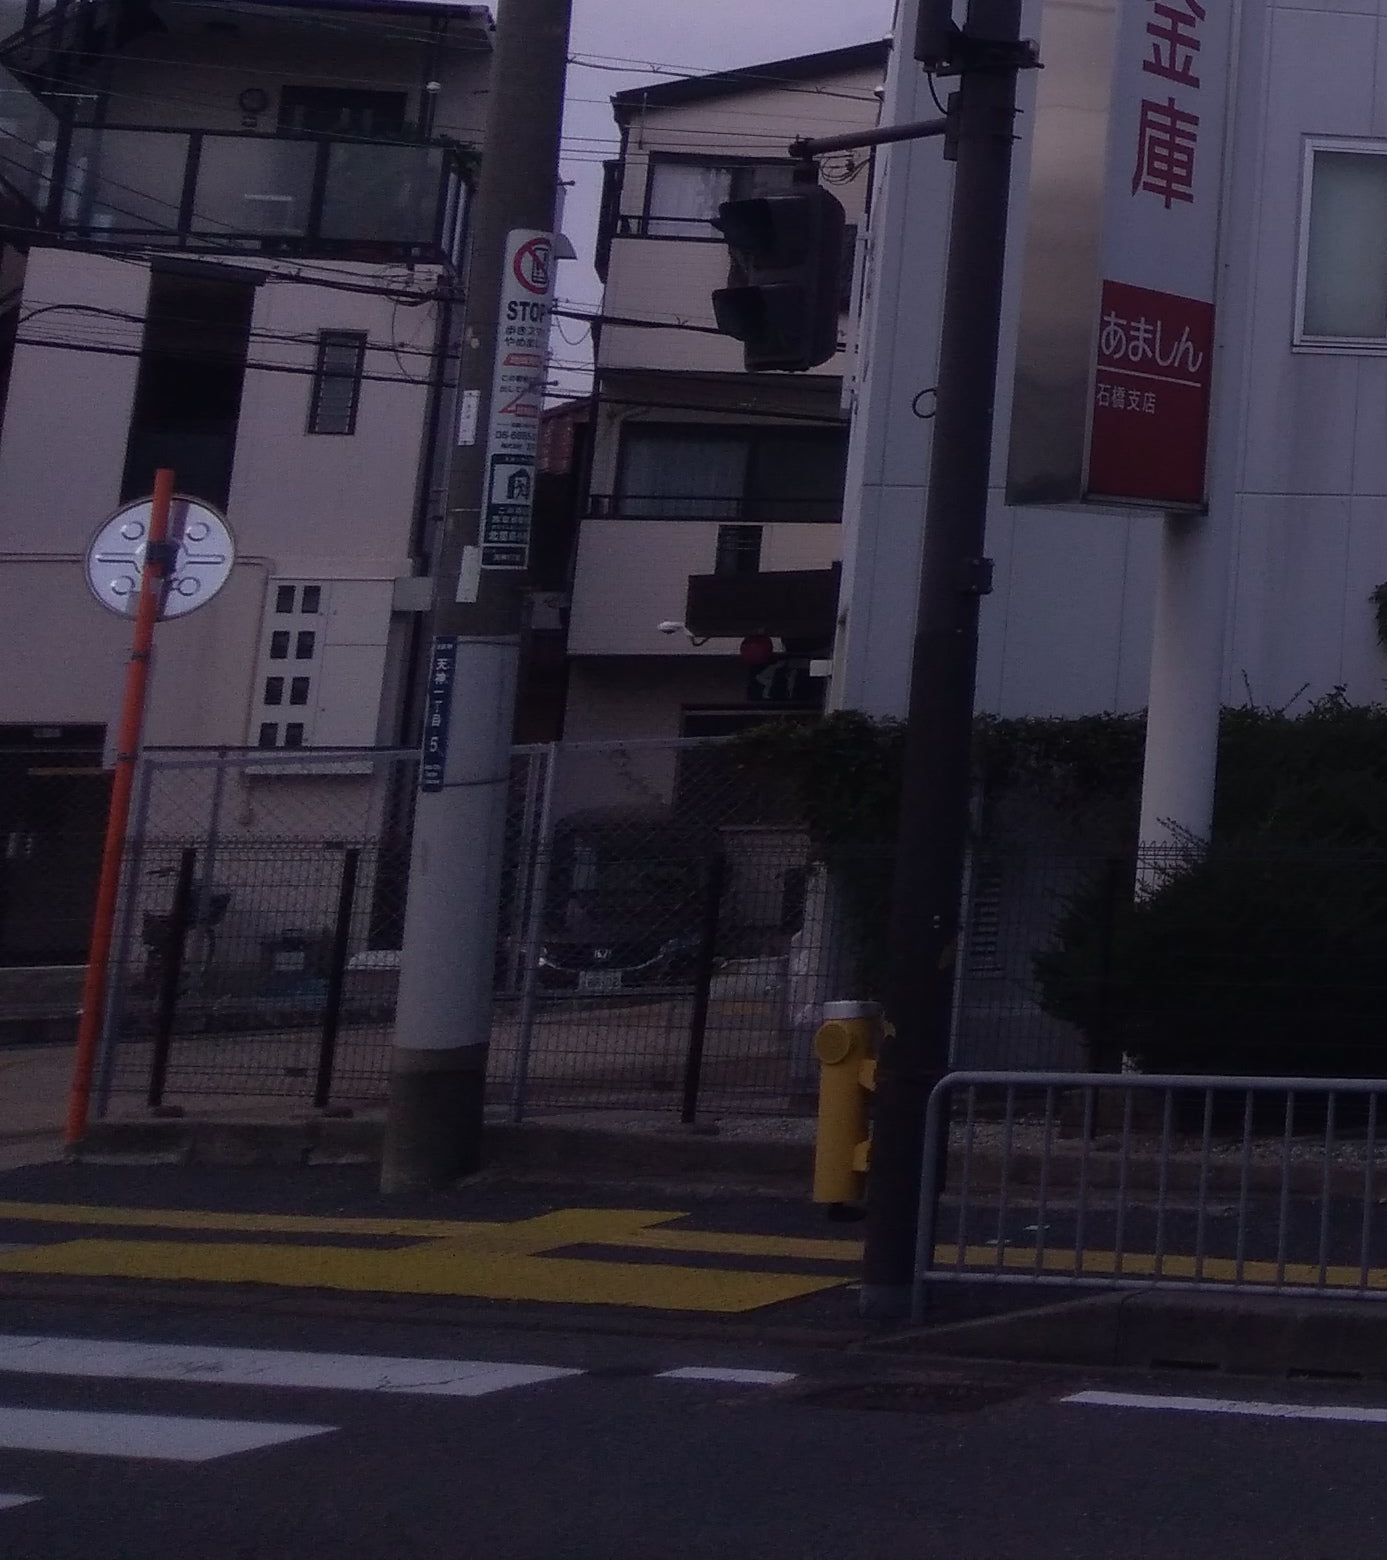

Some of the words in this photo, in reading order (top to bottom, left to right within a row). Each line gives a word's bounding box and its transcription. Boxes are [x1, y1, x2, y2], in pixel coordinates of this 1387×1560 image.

[1101, 310, 1204, 373] あましん
[1096, 382, 1157, 415] 石橋支店
[429, 736, 439, 752] 5
